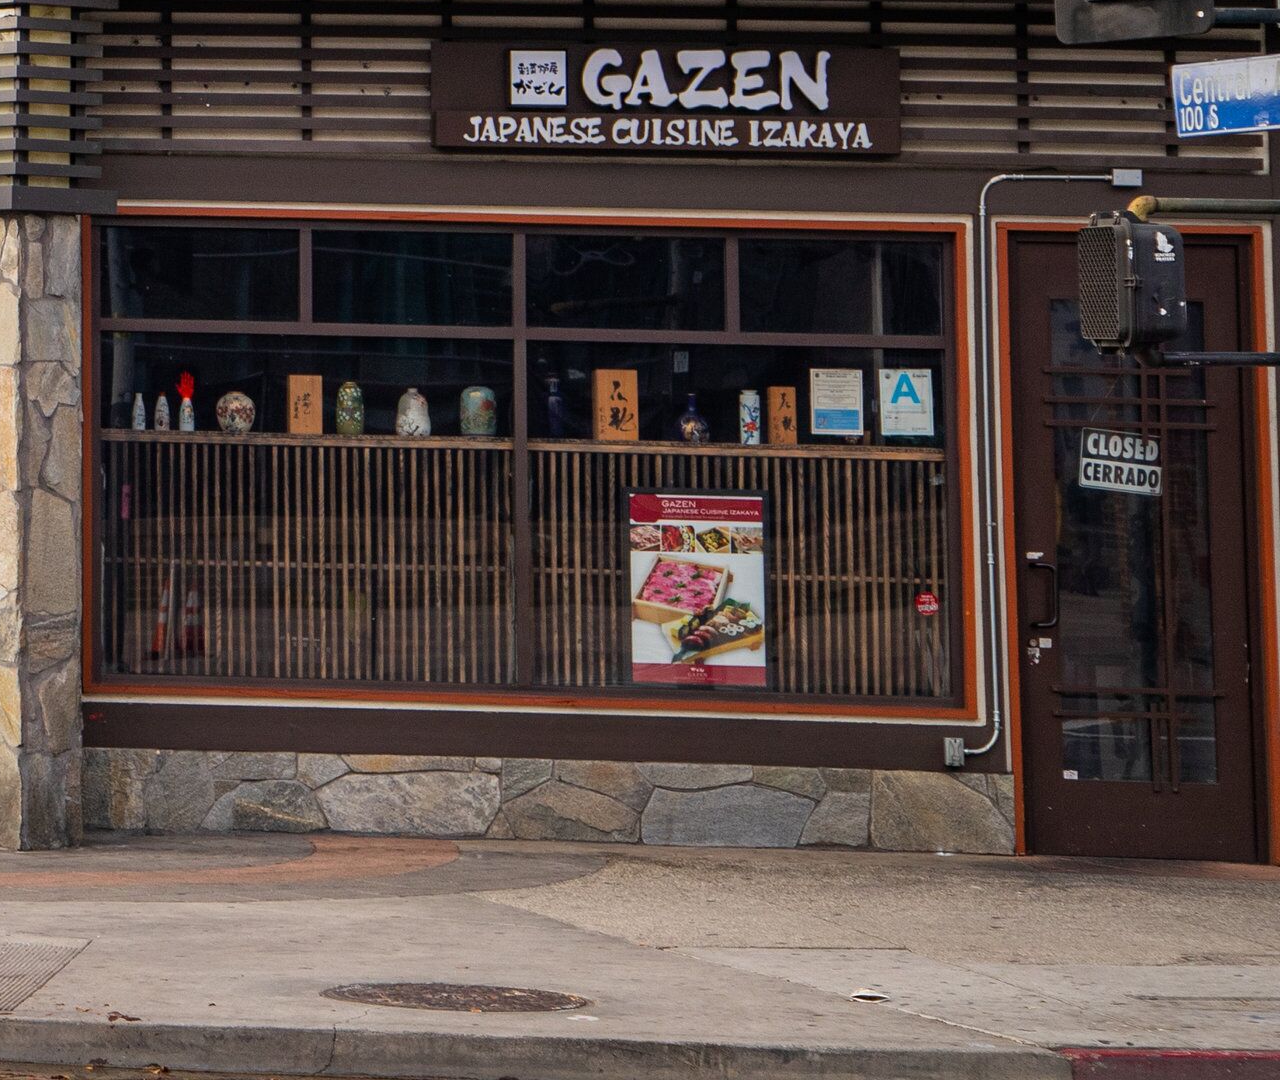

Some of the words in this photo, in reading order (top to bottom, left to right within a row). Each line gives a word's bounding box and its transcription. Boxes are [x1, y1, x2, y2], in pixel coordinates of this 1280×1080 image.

[581, 48, 832, 111] GAZEN
[1180, 70, 1251, 106] Central
[1180, 105, 1203, 132] 100
[1208, 104, 1219, 129] S
[463, 116, 606, 146] JAPANESE
[612, 117, 739, 147] CUISINE
[748, 120, 873, 150] IZAKAYA
[891, 373, 921, 404] A
[1087, 432, 1159, 461] CLOSED
[1083, 461, 1160, 489] CERRADO
[661, 500, 696, 508] GAZEN
[700, 508, 728, 516] CUISINE
[730, 509, 760, 517] IZAKAYA
